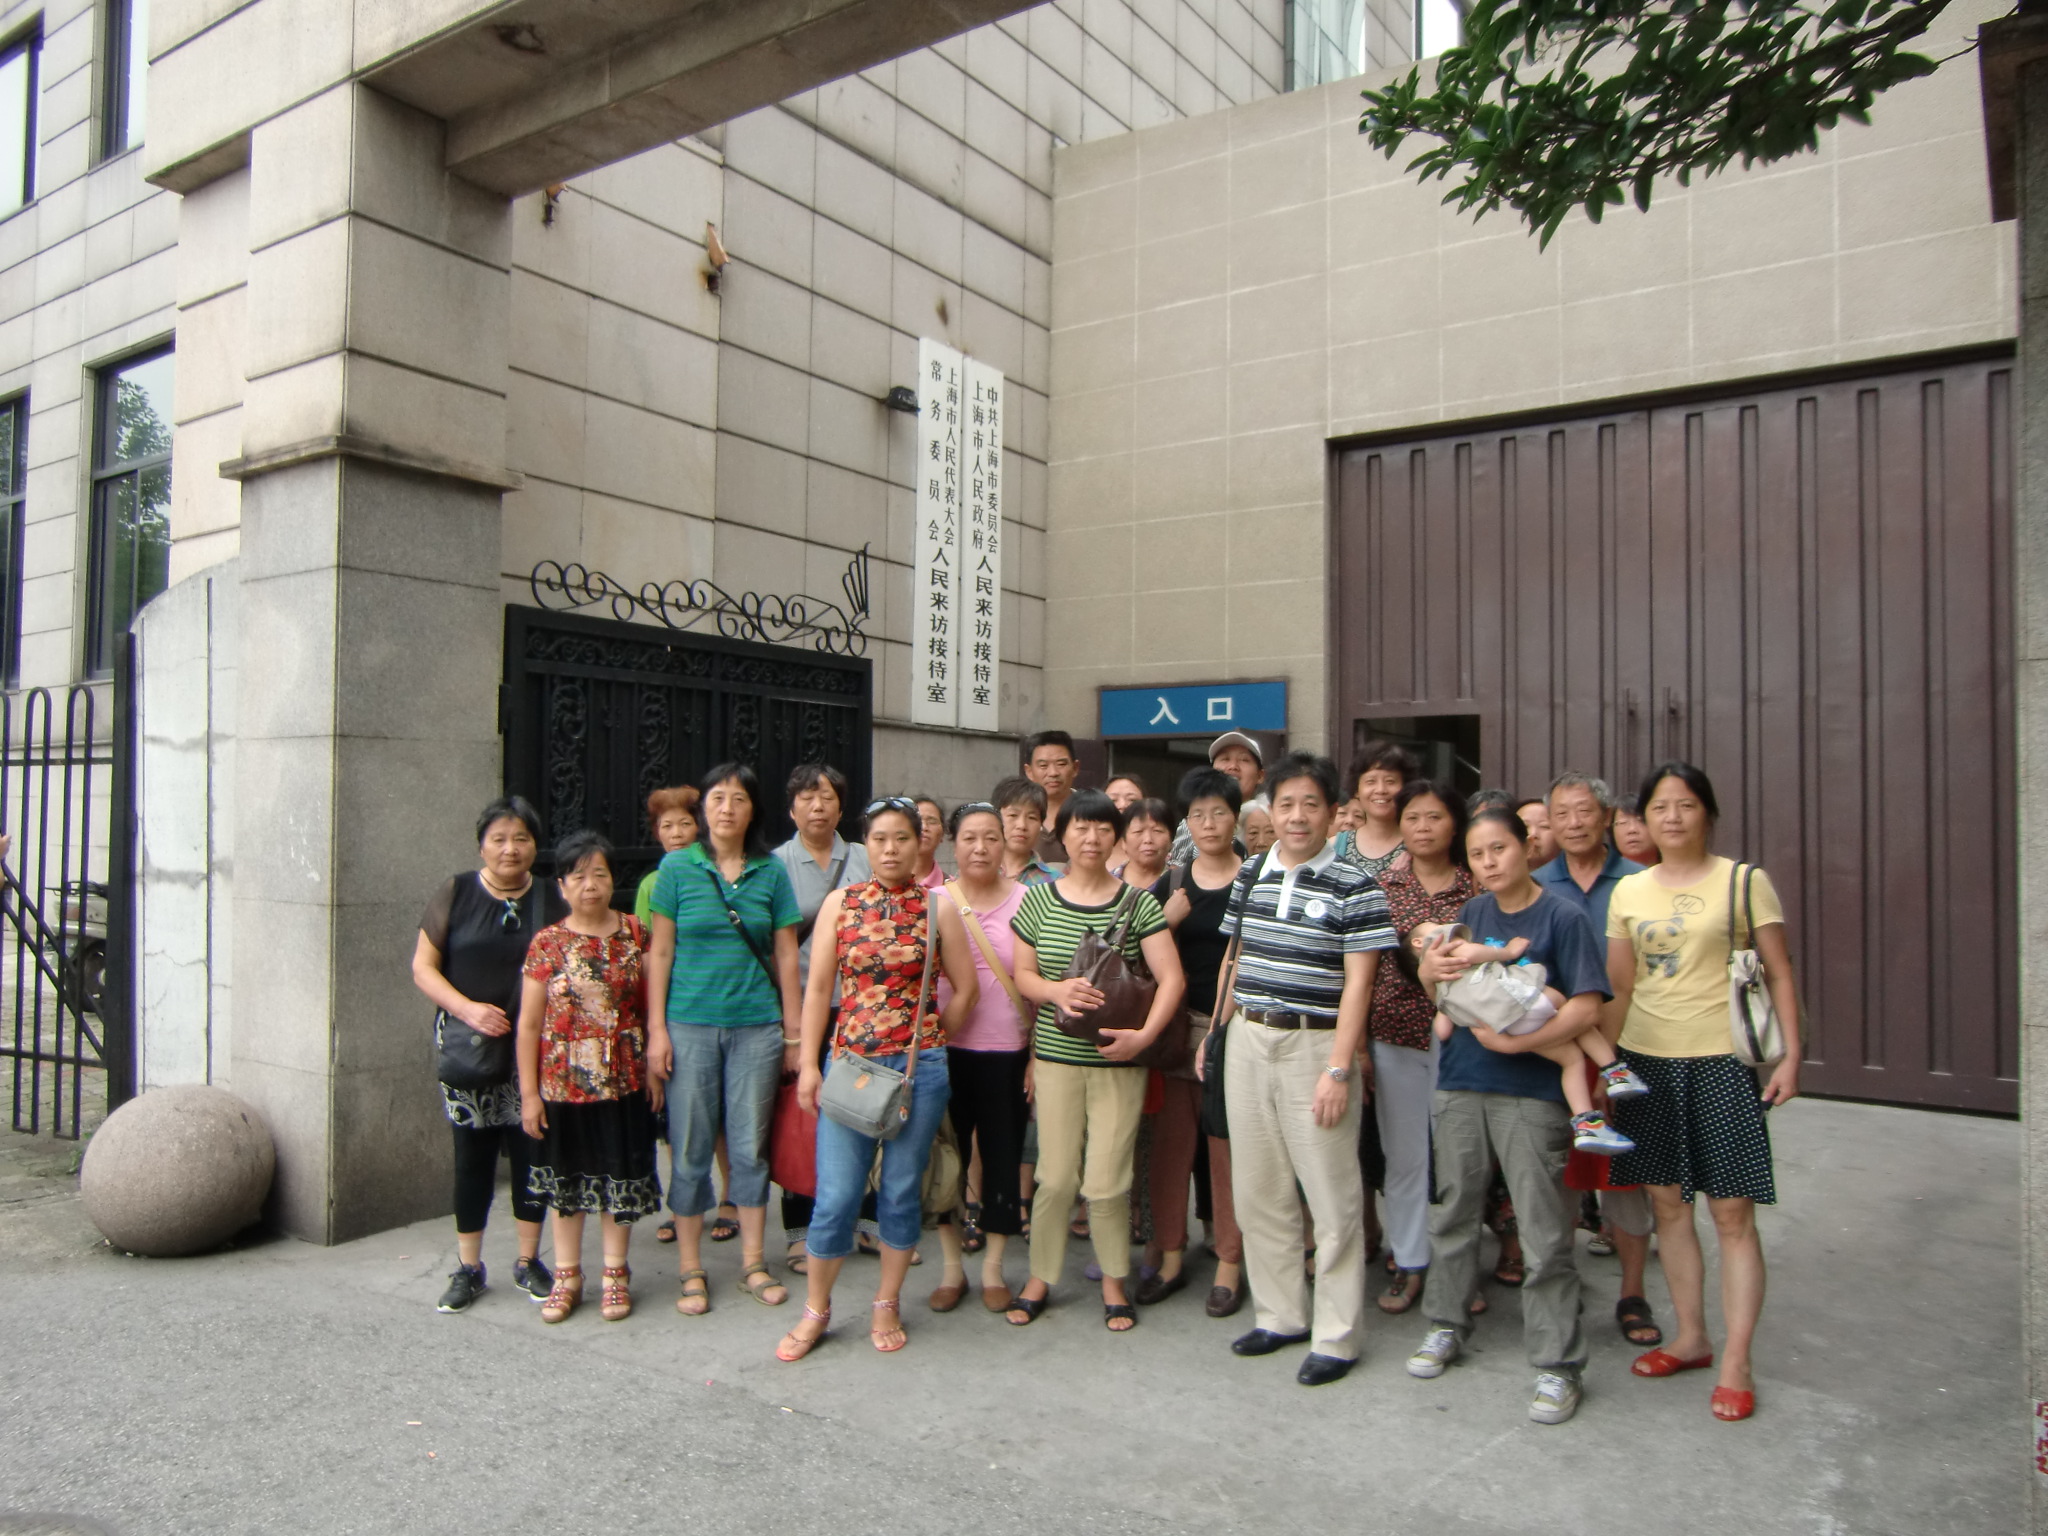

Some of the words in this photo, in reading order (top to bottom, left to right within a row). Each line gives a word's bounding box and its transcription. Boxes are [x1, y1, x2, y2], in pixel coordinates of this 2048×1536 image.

[928, 360, 942, 541] 常务委员会
[944, 367, 957, 546] 上海市人民代表大会
[972, 381, 984, 550] 上海市人民政府
[987, 387, 998, 553] 中共上海市委员会
[927, 547, 950, 704] 人民来访接待室
[973, 555, 994, 706] 人民来访接待室
[1149, 696, 1233, 726] 入口
